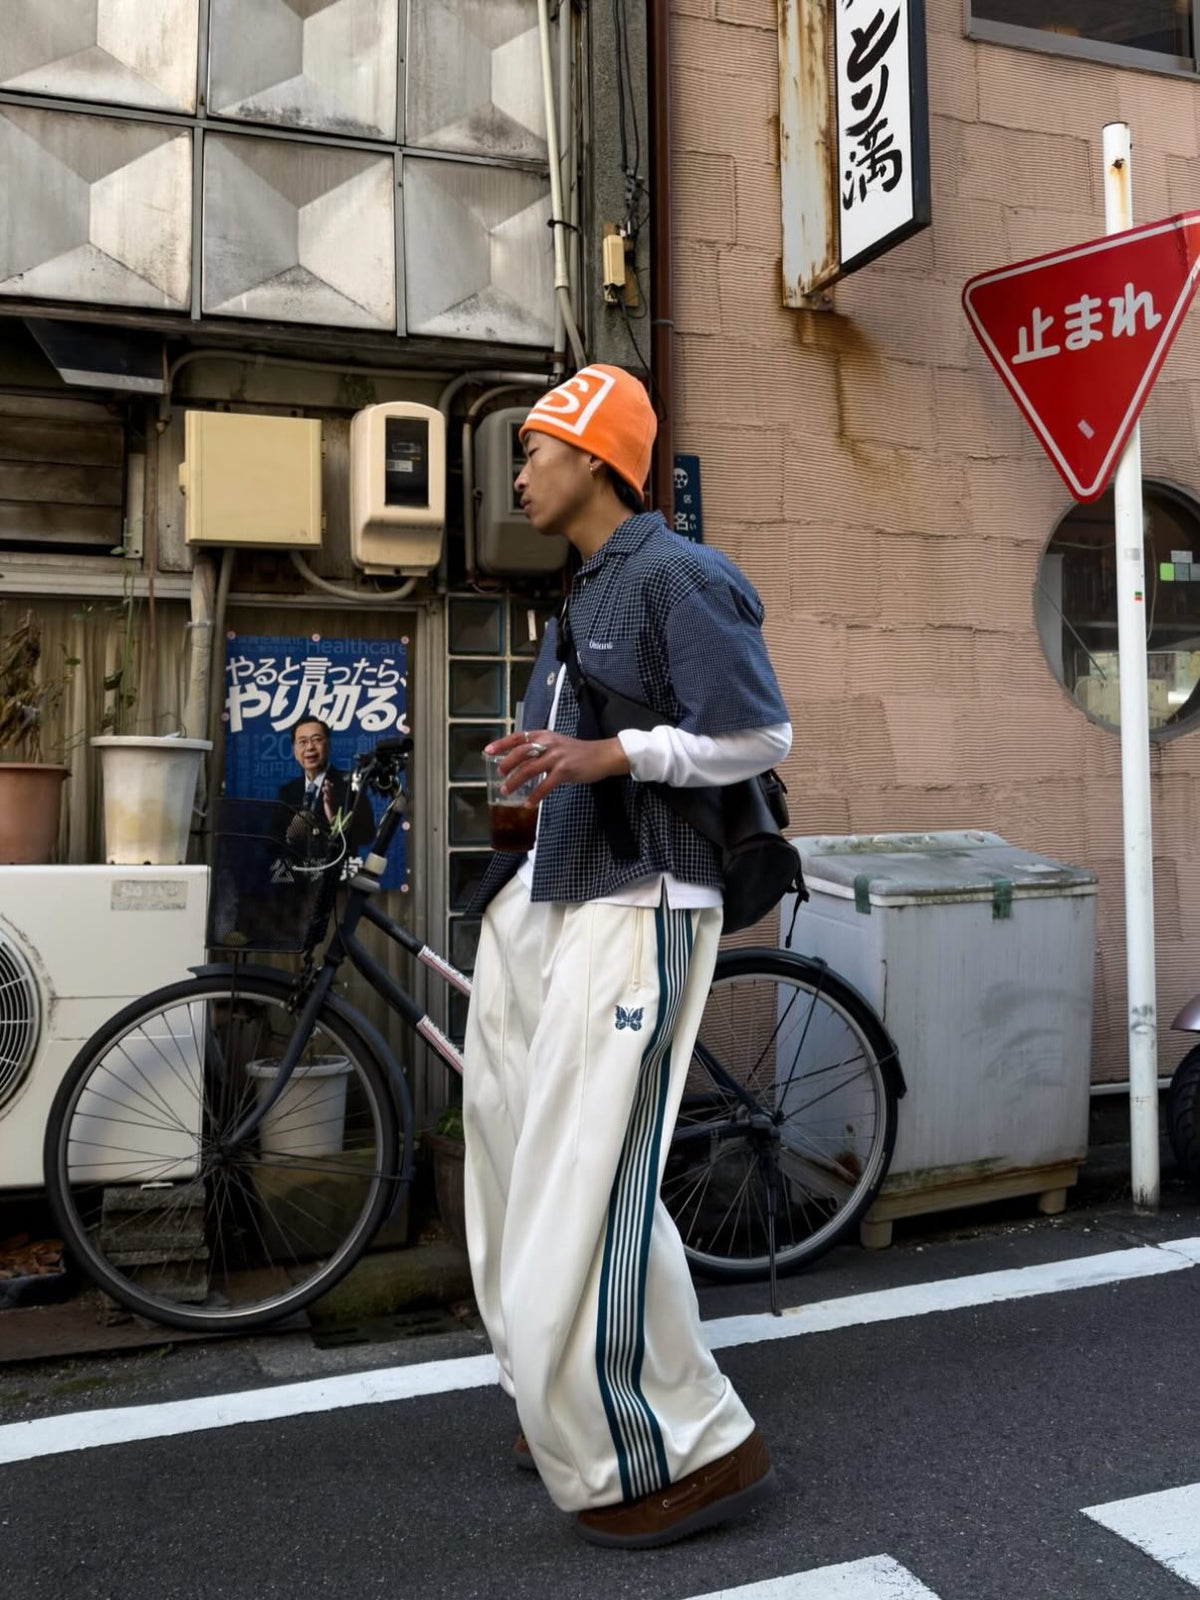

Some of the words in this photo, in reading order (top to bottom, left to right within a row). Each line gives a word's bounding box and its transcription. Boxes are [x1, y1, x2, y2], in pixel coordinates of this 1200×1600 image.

[841, 0, 902, 211] とり満
[1011, 282, 1163, 365] 止まれ
